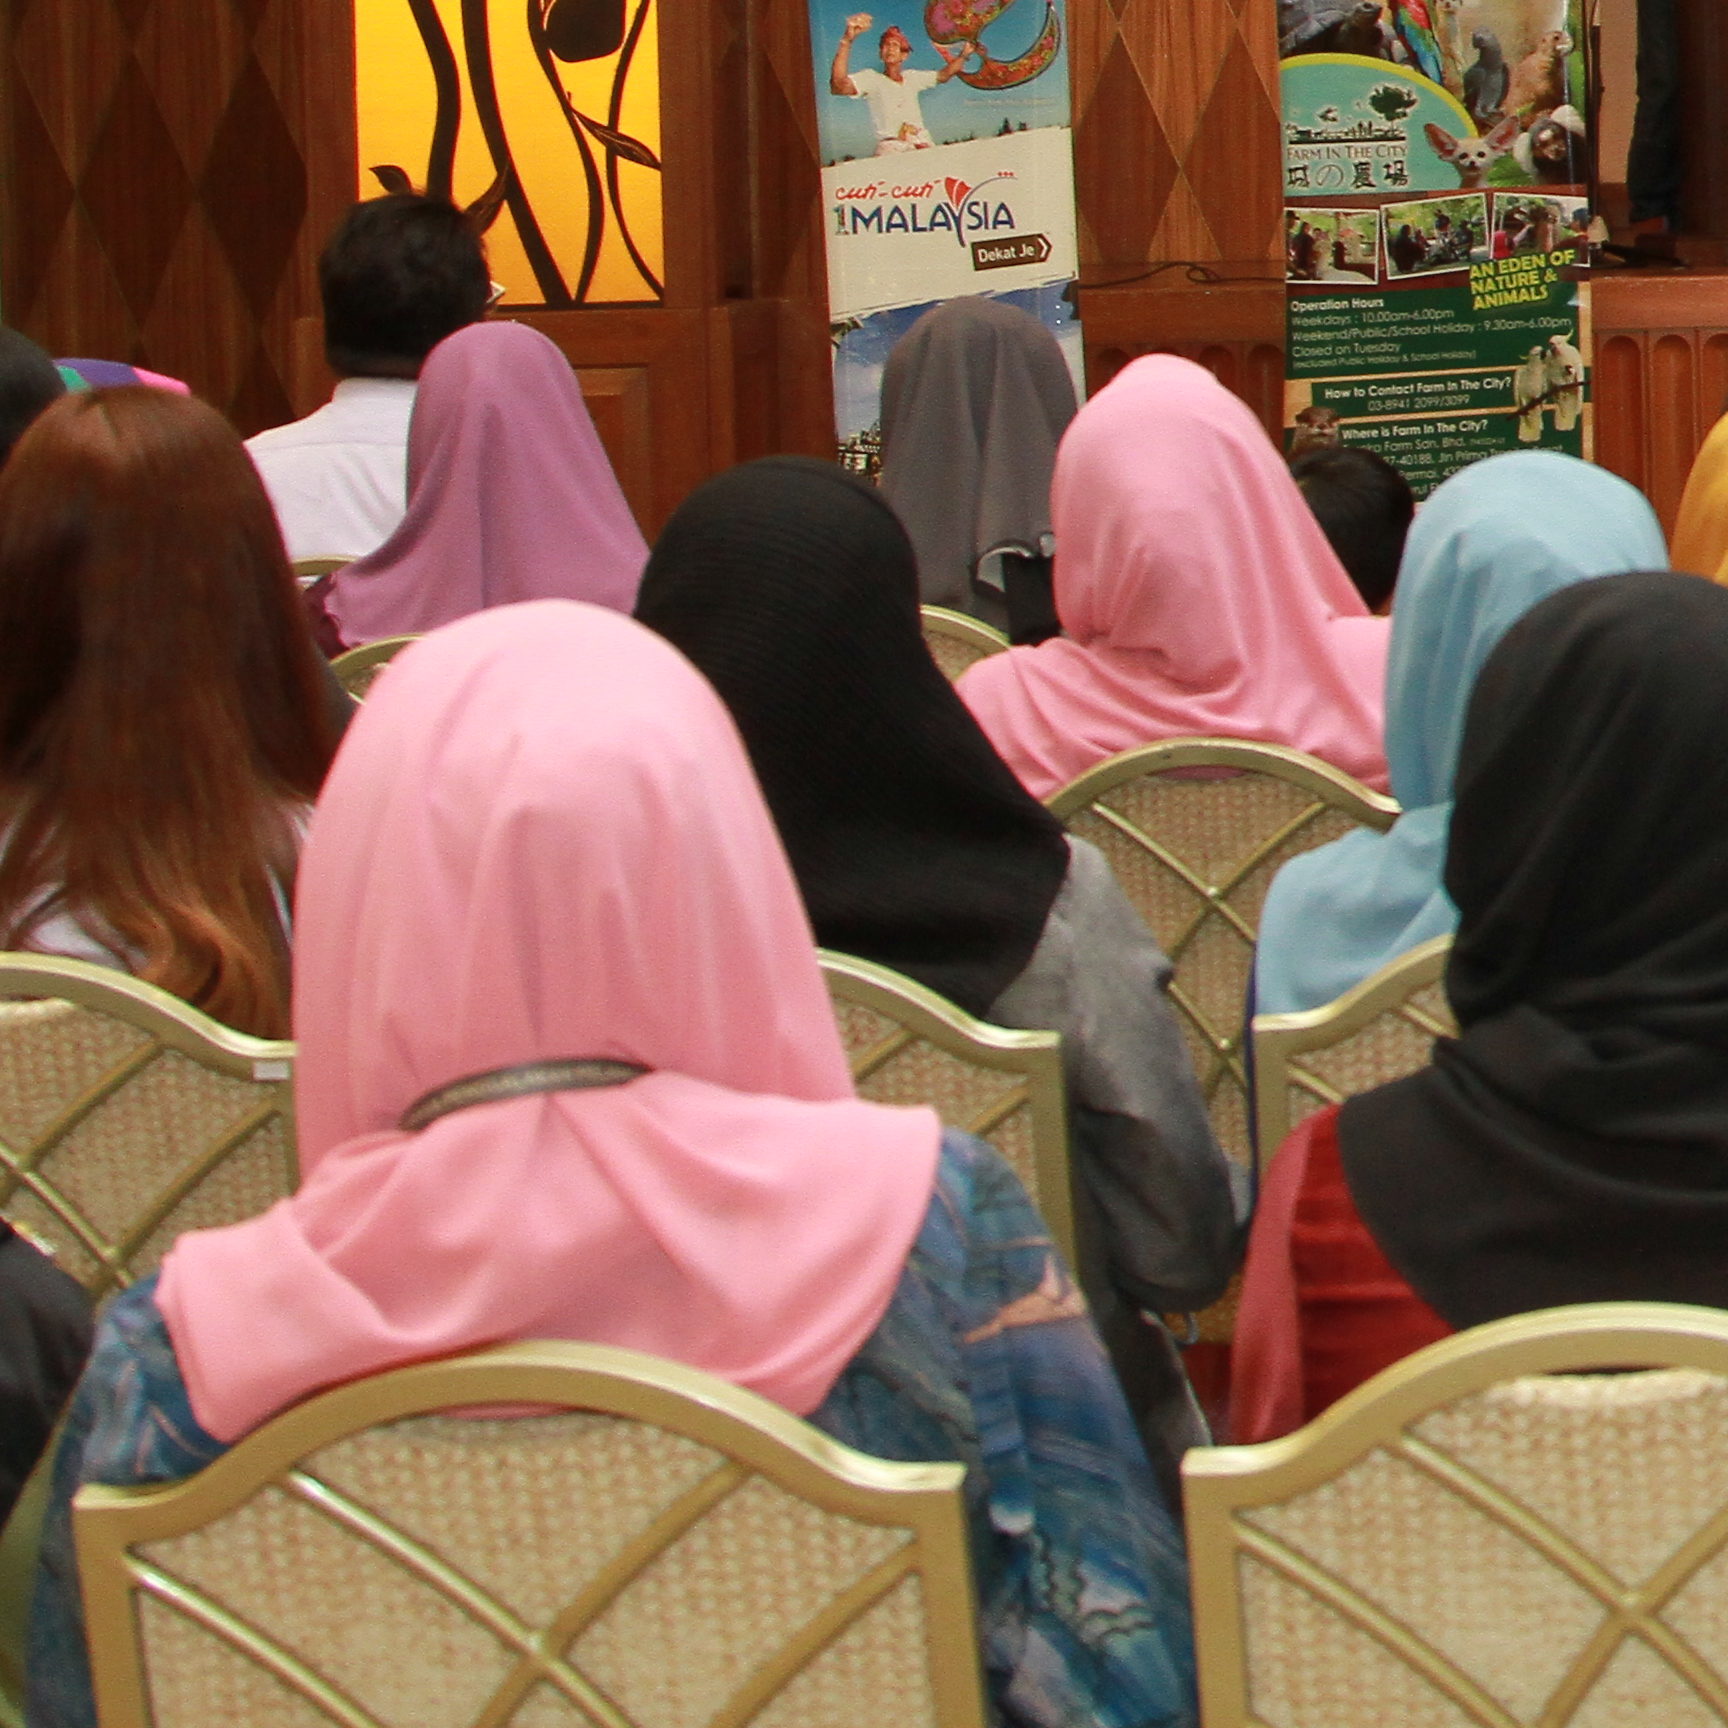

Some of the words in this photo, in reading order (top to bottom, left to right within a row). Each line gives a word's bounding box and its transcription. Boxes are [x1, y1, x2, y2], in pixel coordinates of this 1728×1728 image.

[1286, 147, 1321, 159] FARM
[1327, 146, 1341, 159] IN
[1346, 145, 1373, 159] THE
[1377, 144, 1407, 158] CITY
[977, 246, 1017, 263] Dekat
[1019, 243, 1035, 258] Je
[1470, 262, 1495, 279] AN
[1498, 254, 1546, 274] EDEN
[1549, 249, 1576, 266] OF
[1470, 270, 1540, 294] NATURE
[1544, 268, 1558, 284] &
[1290, 298, 1349, 313] Operation
[1352, 297, 1384, 308] Hours
[1473, 284, 1549, 310] ANIMALS
[1292, 344, 1332, 357] Closed
[1335, 345, 1350, 355] on
[1353, 341, 1401, 353] Tuesday
[1325, 388, 1351, 399] How
[1354, 386, 1365, 397] to
[1368, 384, 1414, 396] Contact
[1417, 381, 1445, 393] Farm
[1447, 379, 1458, 390] In
[1460, 378, 1480, 390] The
[1483, 376, 1512, 390] City?
[1342, 427, 1379, 440] Where
[1381, 424, 1390, 436] is
[1393, 423, 1421, 436] Farm
[1424, 422, 1434, 434] In
[1436, 420, 1457, 432] The
[1458, 419, 1488, 432] City?
[1384, 441, 1413, 451] Farm
